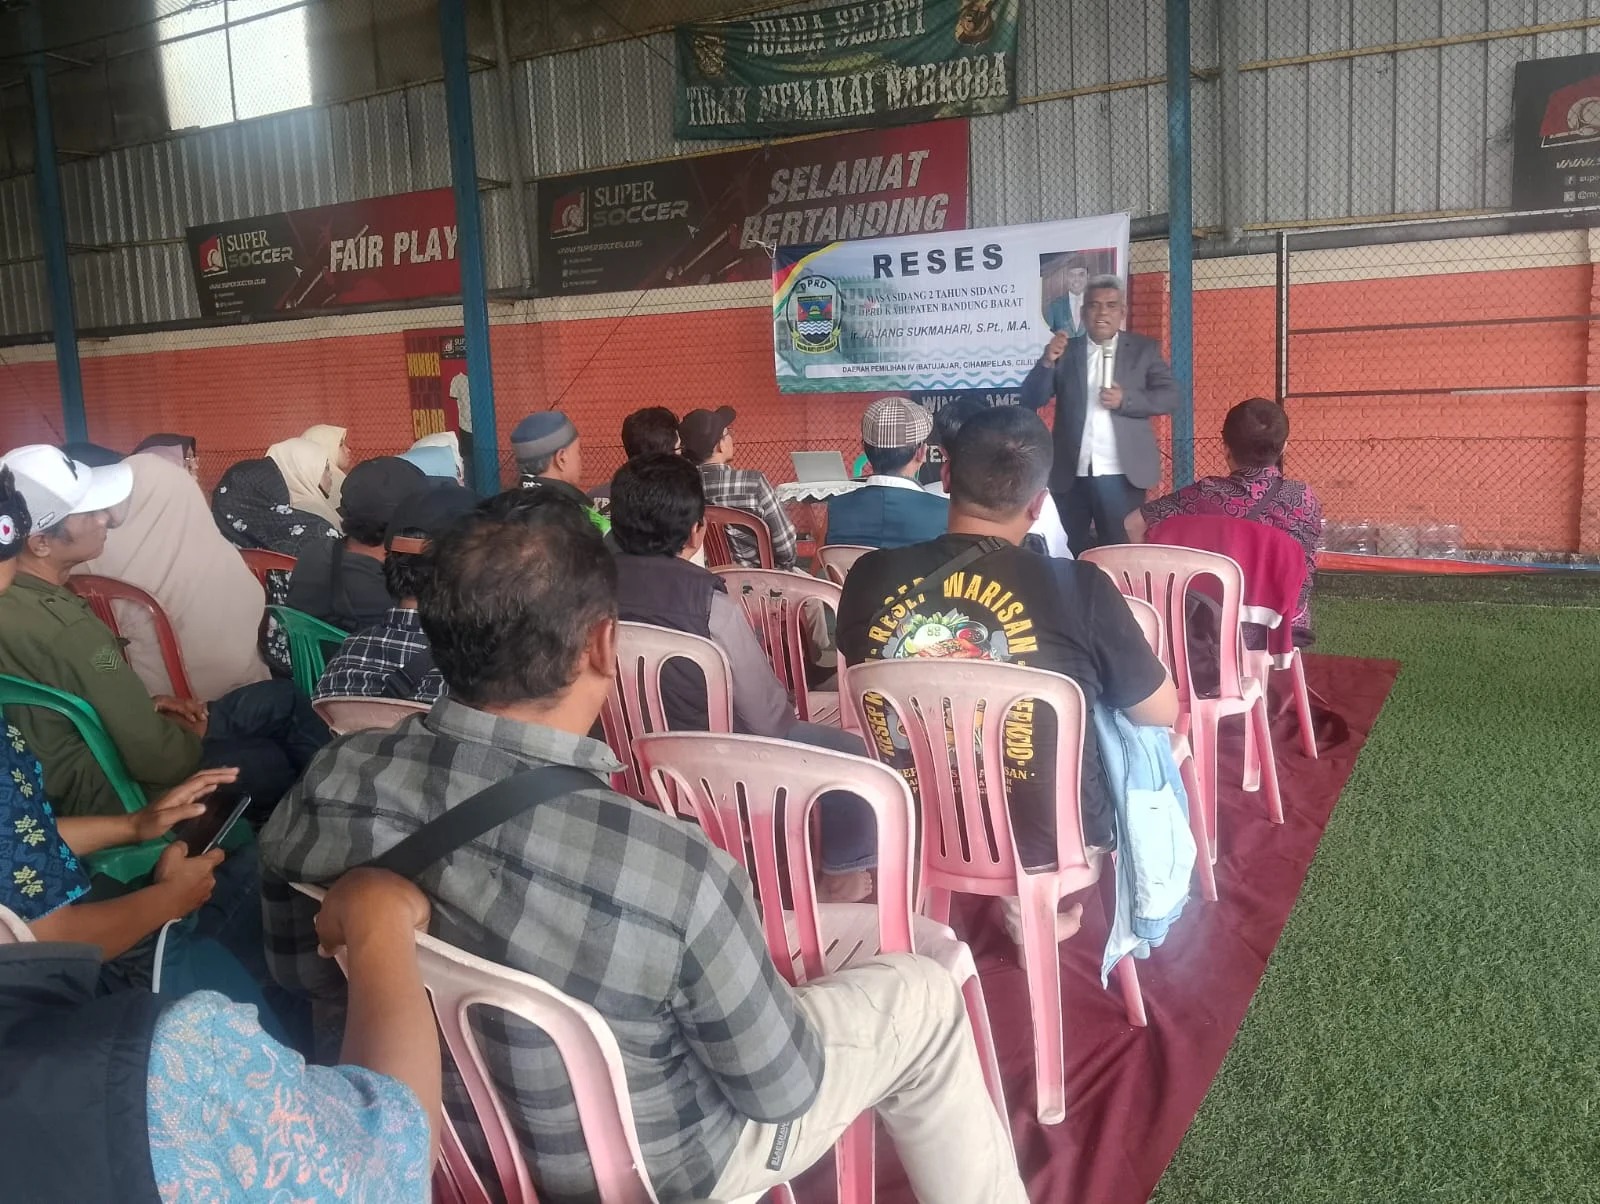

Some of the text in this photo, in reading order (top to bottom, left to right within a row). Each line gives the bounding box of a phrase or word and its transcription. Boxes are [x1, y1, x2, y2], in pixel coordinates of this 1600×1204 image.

[884, 52, 1009, 110] NARKOBA
[768, 150, 930, 205] SELAMAT
[594, 181, 657, 208] SUPER
[592, 200, 689, 228] SOCCER
[740, 193, 949, 249] BERTANDING
[226, 230, 271, 252] SUPER
[330, 225, 457, 272] FAIR PLAY
[228, 246, 294, 268] SOCCER
[872, 244, 1003, 279] RESES
[800, 280, 827, 290] DPRD
[866, 284, 1016, 304] MASA SIDANG 2 TAHUN SIDANG 2
[859, 297, 1024, 317] DPRD KABUPATEN BANDUNG BARAT
[863, 327, 904, 340] JAJANG
[906, 323, 973, 337] SUKMAHARI,
[1006, 320, 1031, 332] M.A.
[842, 365, 870, 374] DAERAH
[870, 363, 907, 373] PEMILIHAN
[907, 362, 915, 371] IV
[943, 572, 1038, 654] WARISAN
